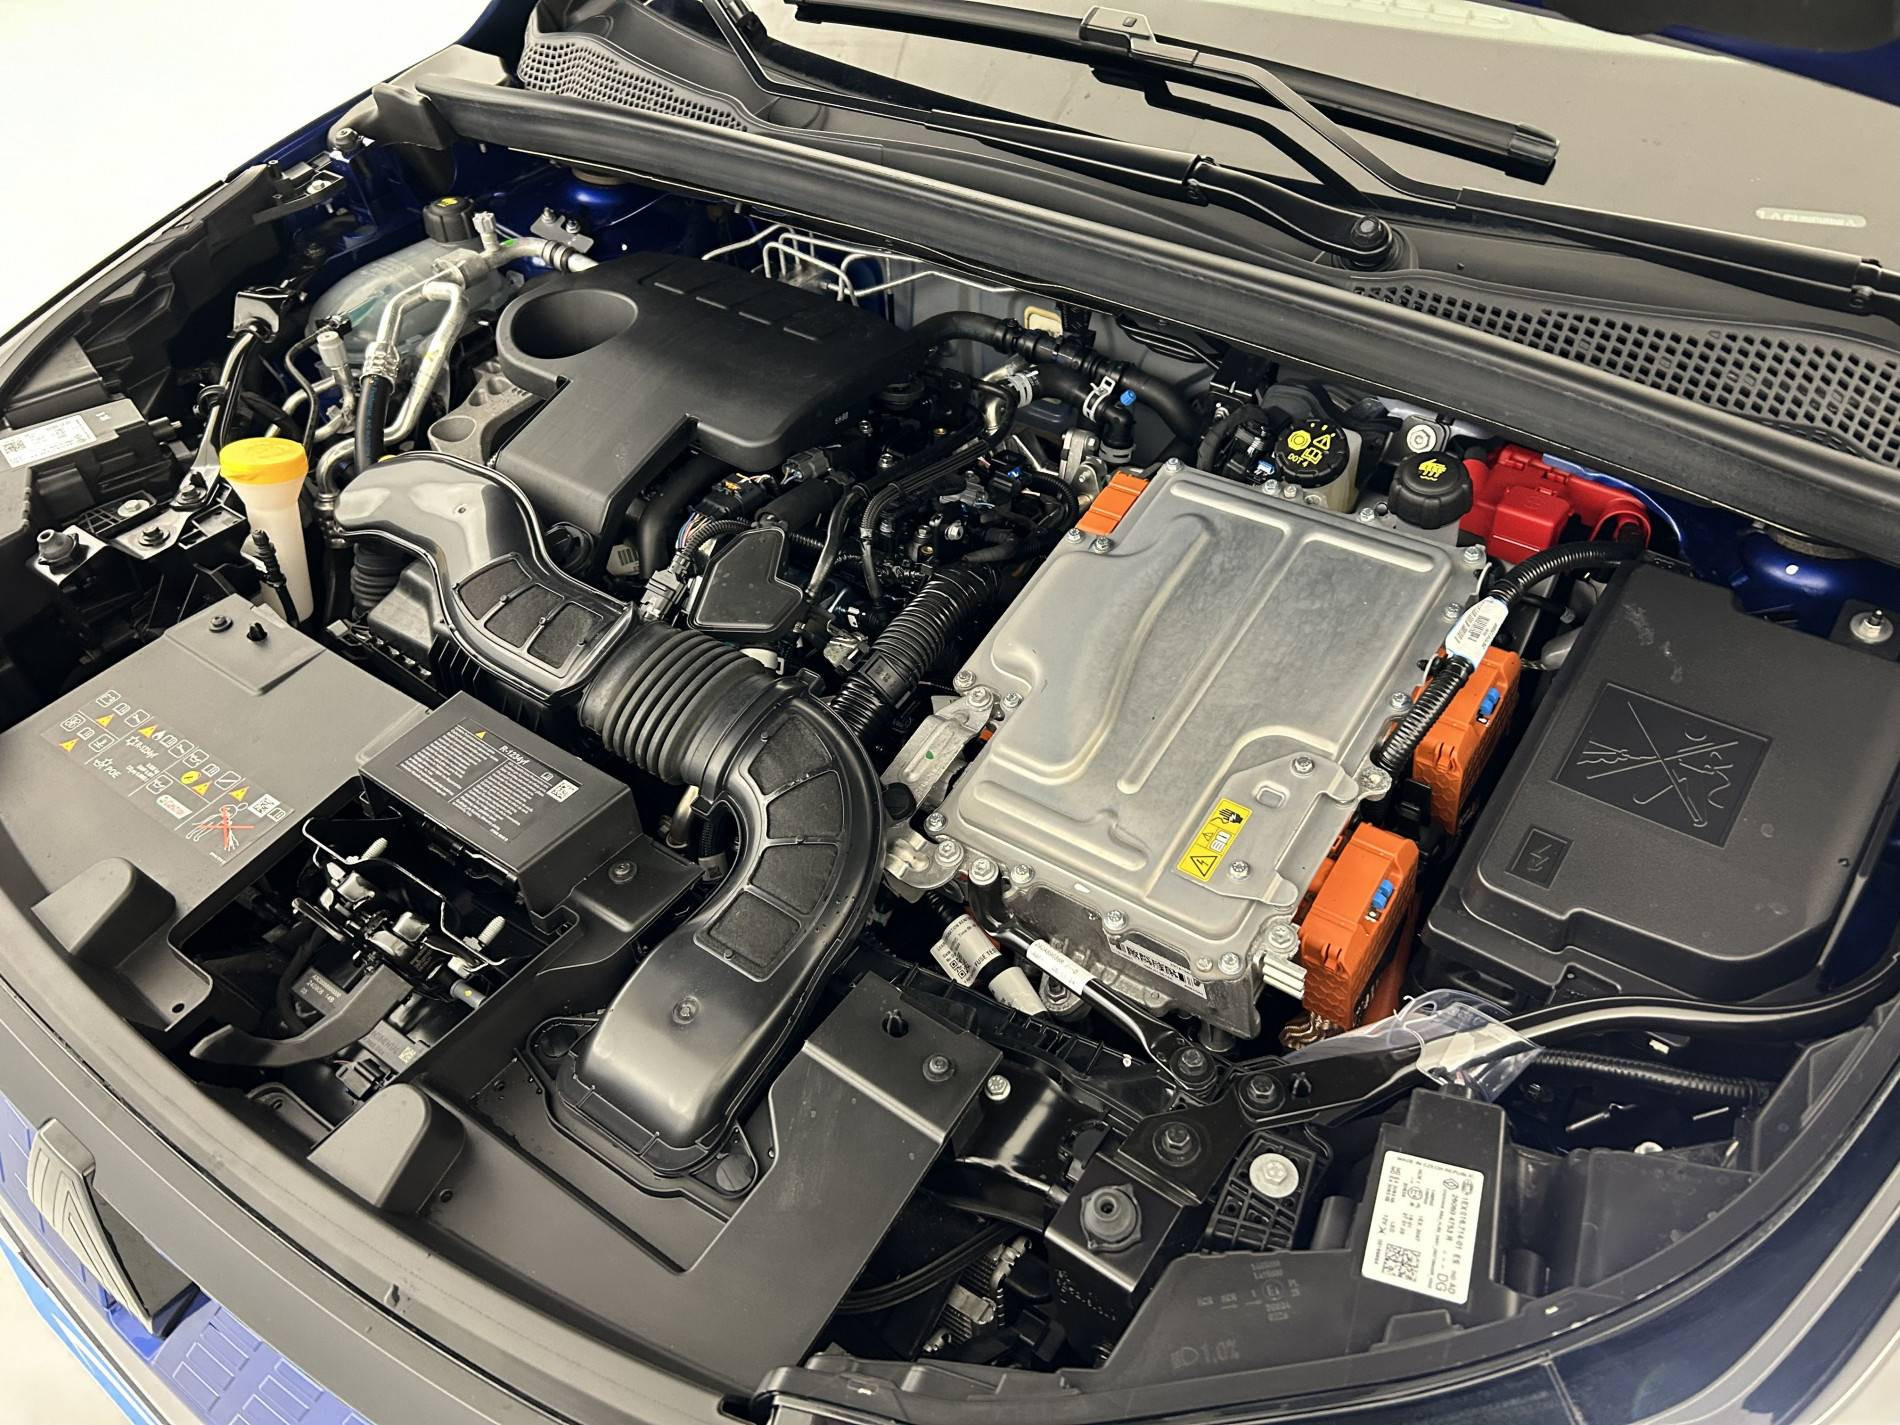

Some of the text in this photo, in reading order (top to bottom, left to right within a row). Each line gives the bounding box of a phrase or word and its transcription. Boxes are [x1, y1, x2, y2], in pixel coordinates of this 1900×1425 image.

[1288, 453, 1304, 464] DOT
[499, 745, 530, 765] R-1234yf
[1435, 1273, 1449, 1292] DG
